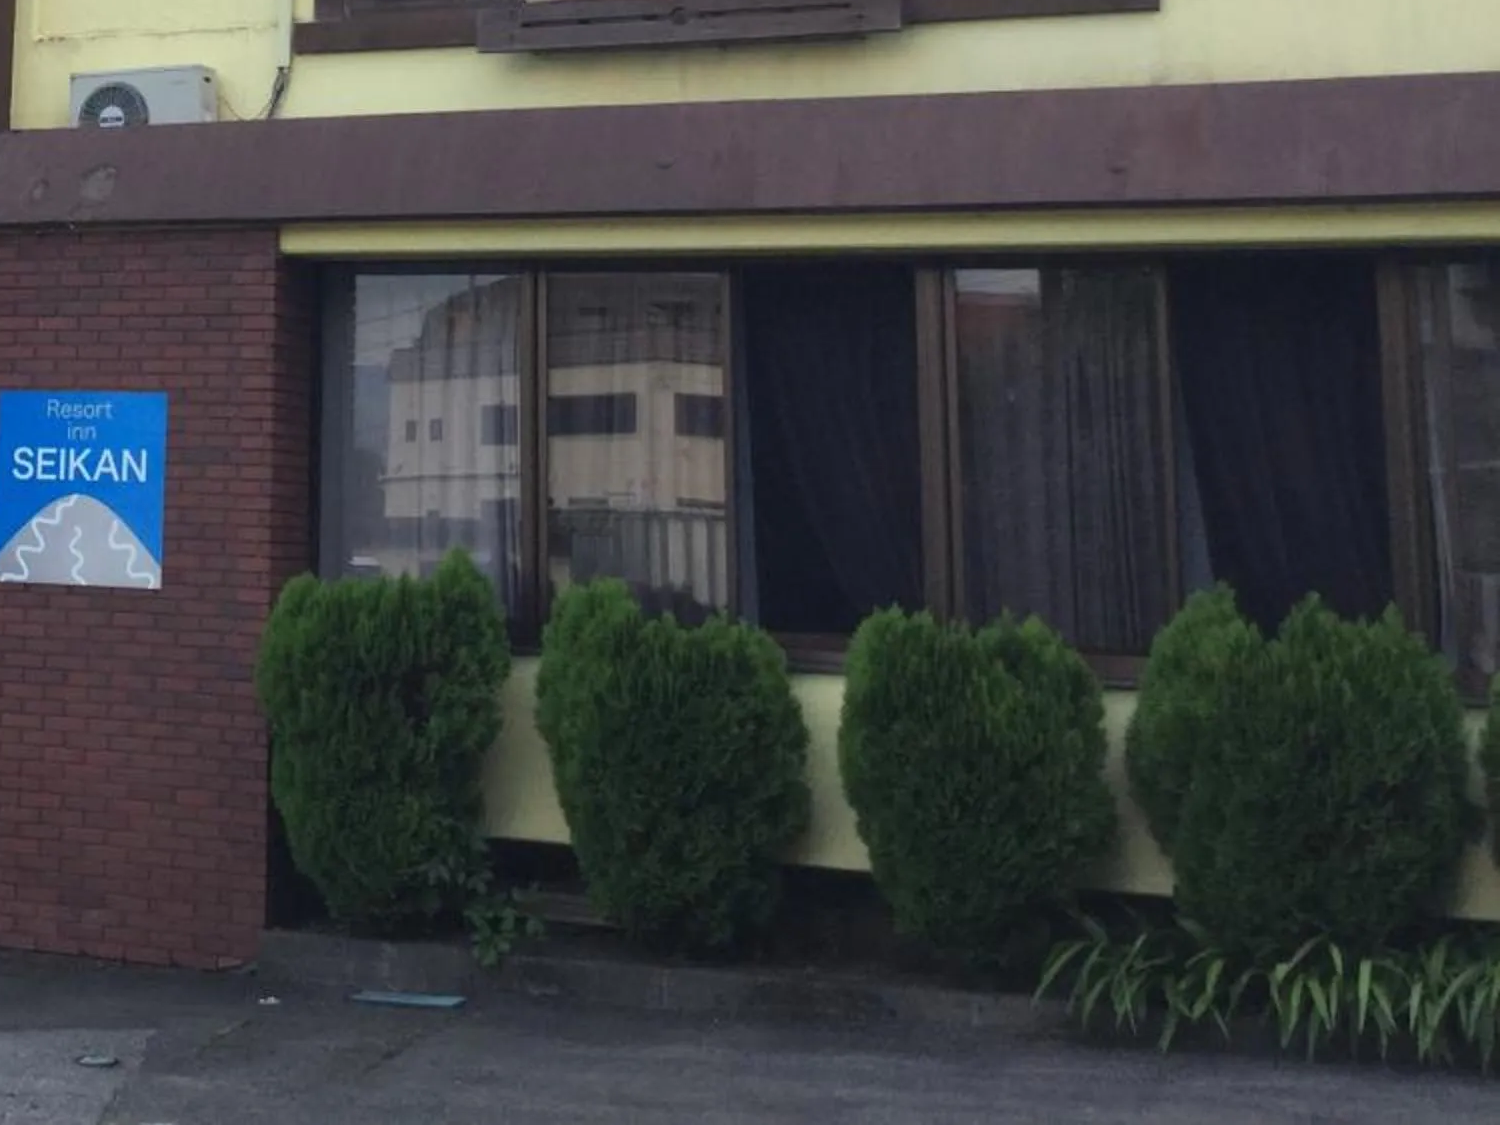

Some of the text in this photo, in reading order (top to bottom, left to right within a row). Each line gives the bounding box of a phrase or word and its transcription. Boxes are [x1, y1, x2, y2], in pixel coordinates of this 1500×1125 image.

[47, 398, 114, 419] Resort
[67, 422, 97, 440] inn
[12, 446, 148, 483] SEIKAN
